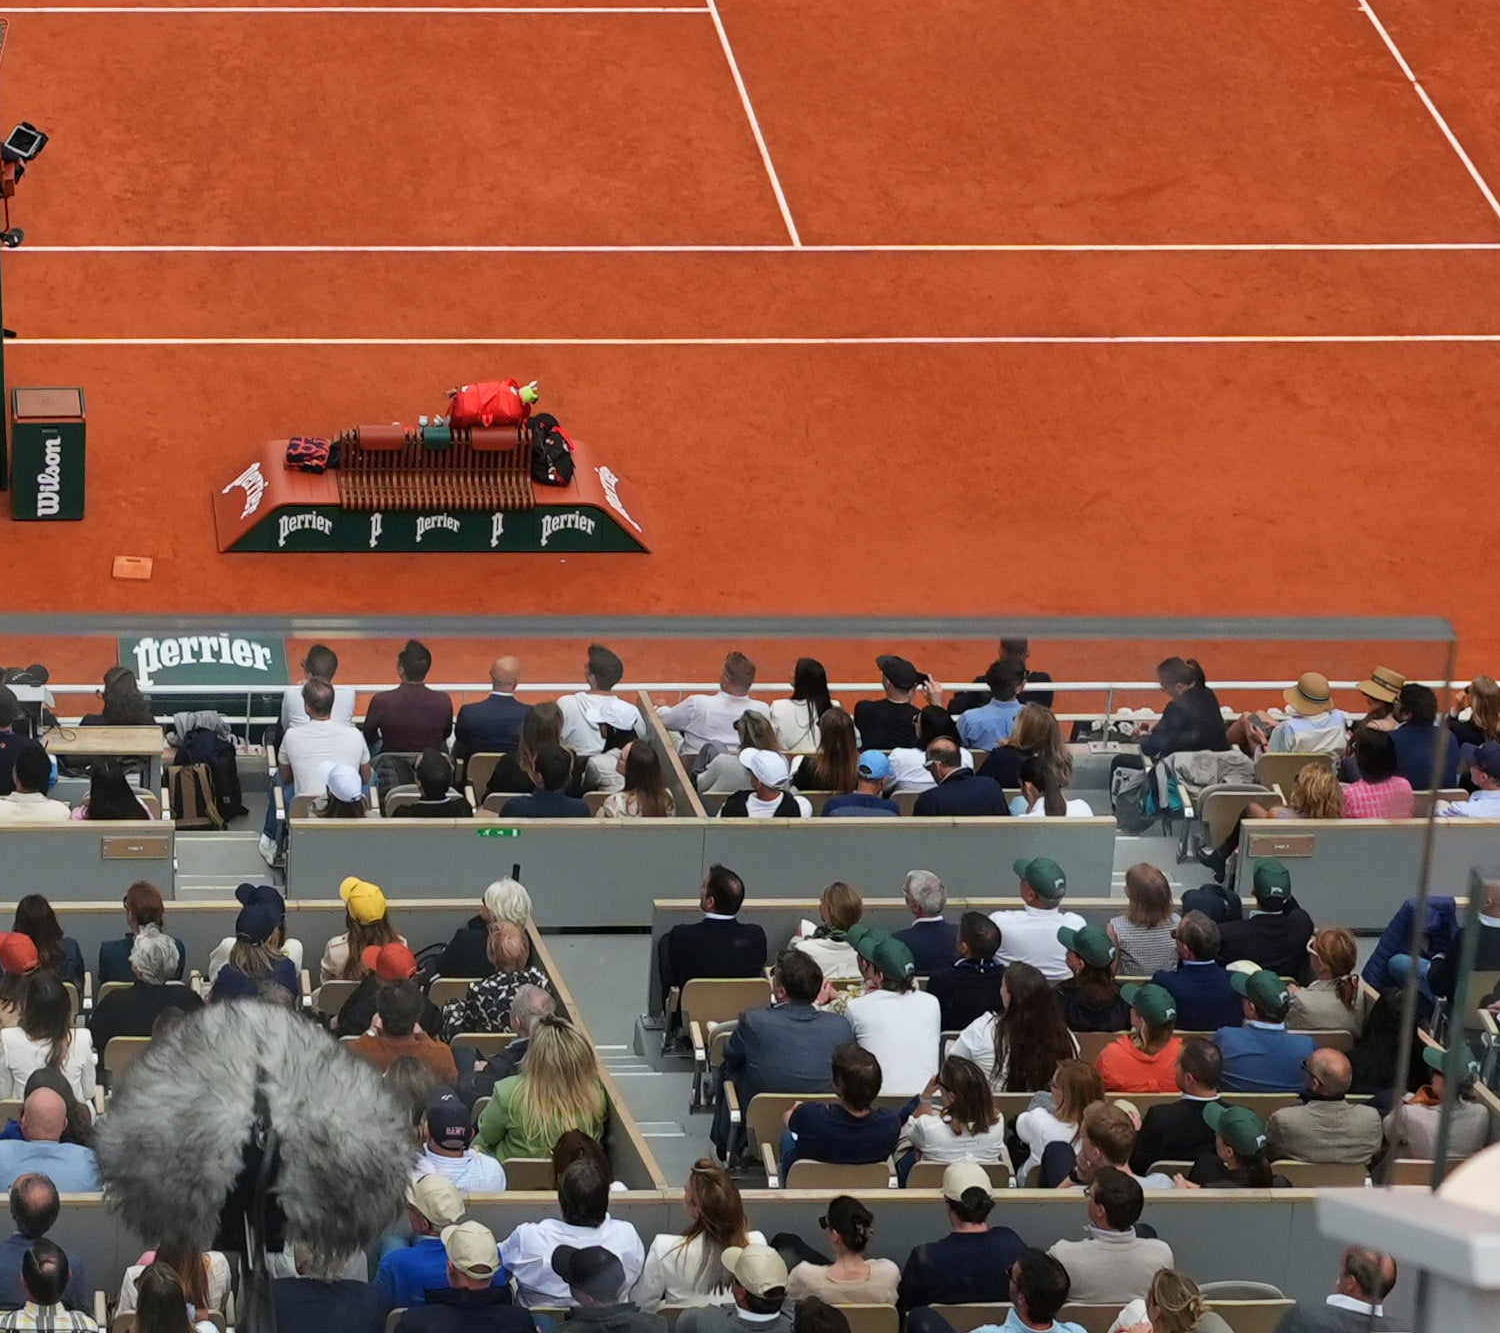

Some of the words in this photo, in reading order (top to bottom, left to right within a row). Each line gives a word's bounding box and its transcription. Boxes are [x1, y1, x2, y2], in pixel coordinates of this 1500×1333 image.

[37, 435, 61, 517] Wilson
[278, 510, 332, 547] perrier
[415, 511, 460, 543] perrier
[540, 510, 595, 547] perrier
[133, 633, 272, 687] perrier
